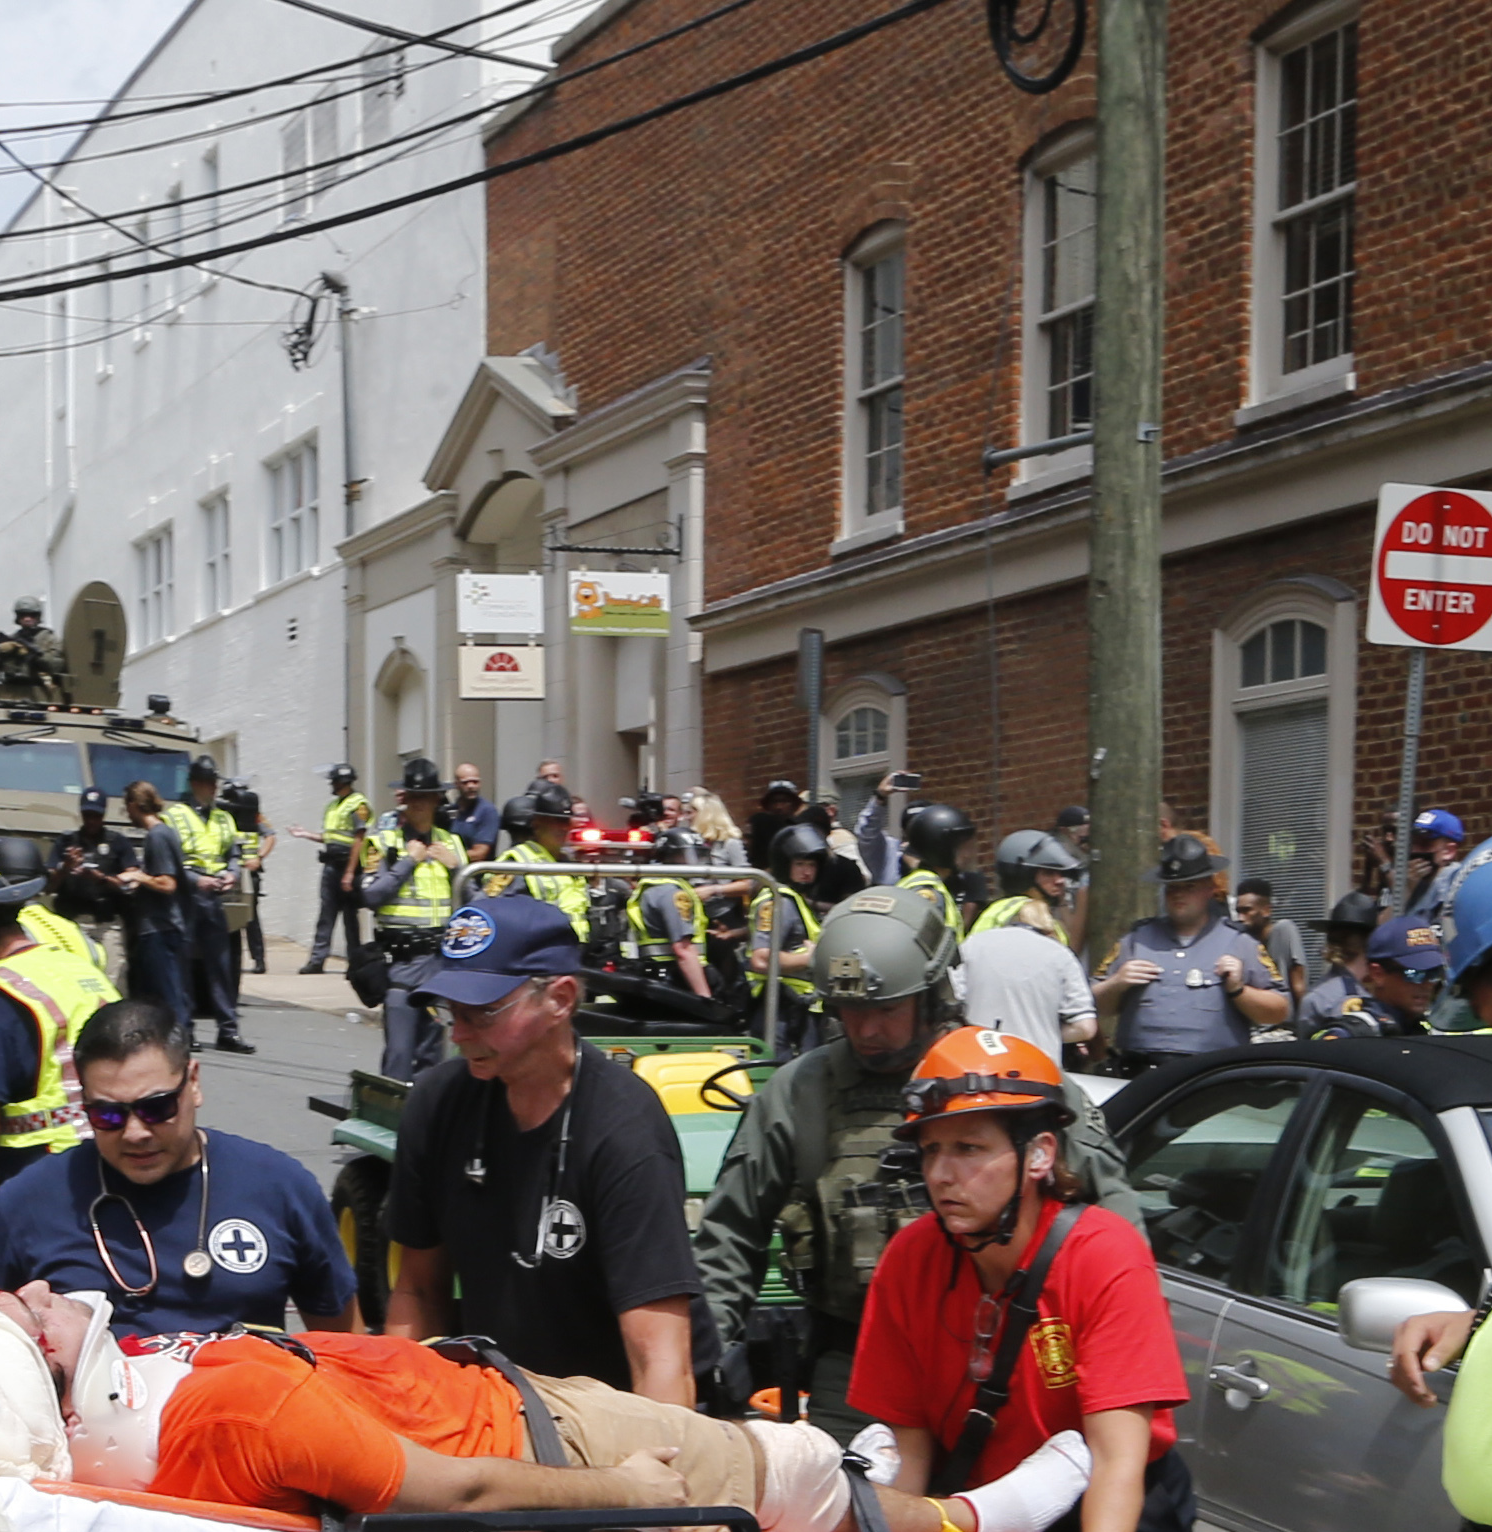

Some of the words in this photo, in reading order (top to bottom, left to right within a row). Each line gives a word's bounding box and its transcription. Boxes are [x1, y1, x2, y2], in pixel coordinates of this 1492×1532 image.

[1401, 520, 1433, 545] DO
[1441, 524, 1490, 549] NOT
[1402, 587, 1476, 615] ENTER
